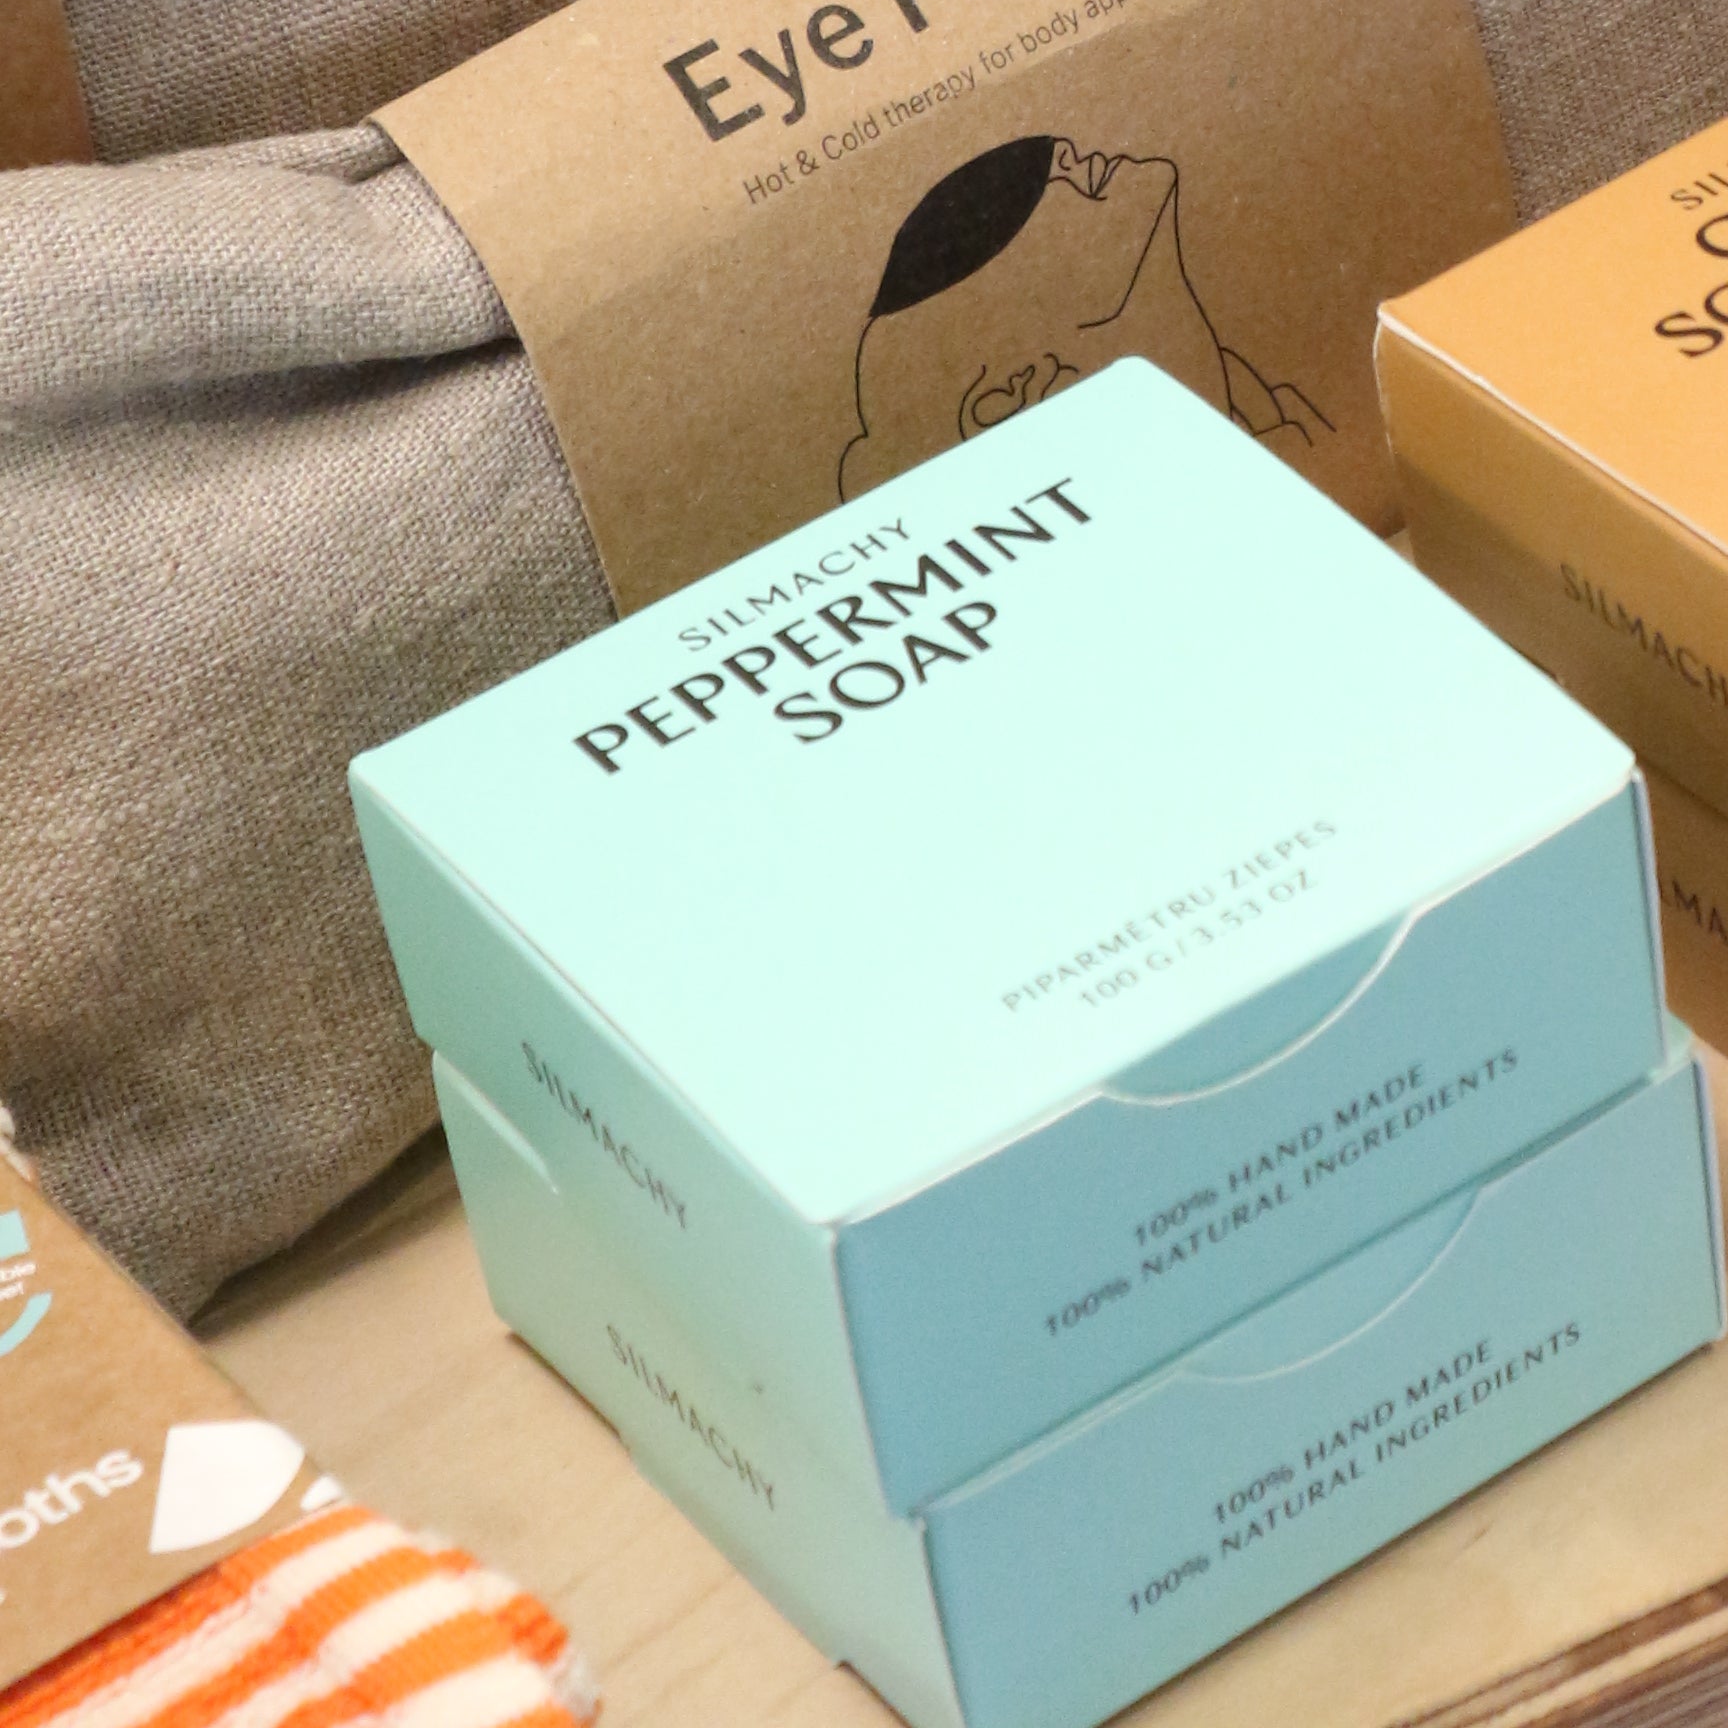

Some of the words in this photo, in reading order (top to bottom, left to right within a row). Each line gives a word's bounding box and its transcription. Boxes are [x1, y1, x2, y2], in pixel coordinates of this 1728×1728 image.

[662, 0, 875, 142] Eye
[743, 167, 795, 205] Hot
[800, 150, 821, 173] &
[821, 115, 881, 161] Cold
[883, 64, 978, 129] therapy
[978, 46, 1015, 76] for
[1021, 10, 1080, 54] body
[572, 476, 1093, 776] PEPPERMINT
[677, 517, 912, 653] SILMACHY
[773, 600, 998, 745] SOAP
[1223, 819, 1337, 891] ZIEPES
[1079, 968, 1139, 1008] 100
[521, 1041, 686, 1230] SILMACHY
[1141, 1182, 1293, 1279] NATURAL
[1302, 1047, 1519, 1187] INGREDIENTS
[1228, 1126, 1324, 1192] HAND
[1334, 1062, 1425, 1131] MADE
[606, 1324, 776, 1512] SILMACHY
[1127, 1557, 1210, 1615] 100%
[1219, 1458, 1365, 1558] NATURAL
[1375, 1322, 1583, 1463] INGREDIENTS
[1214, 1464, 1294, 1523] 100%
[1303, 1400, 1394, 1471] HAND
[1404, 1338, 1491, 1407] MADE
